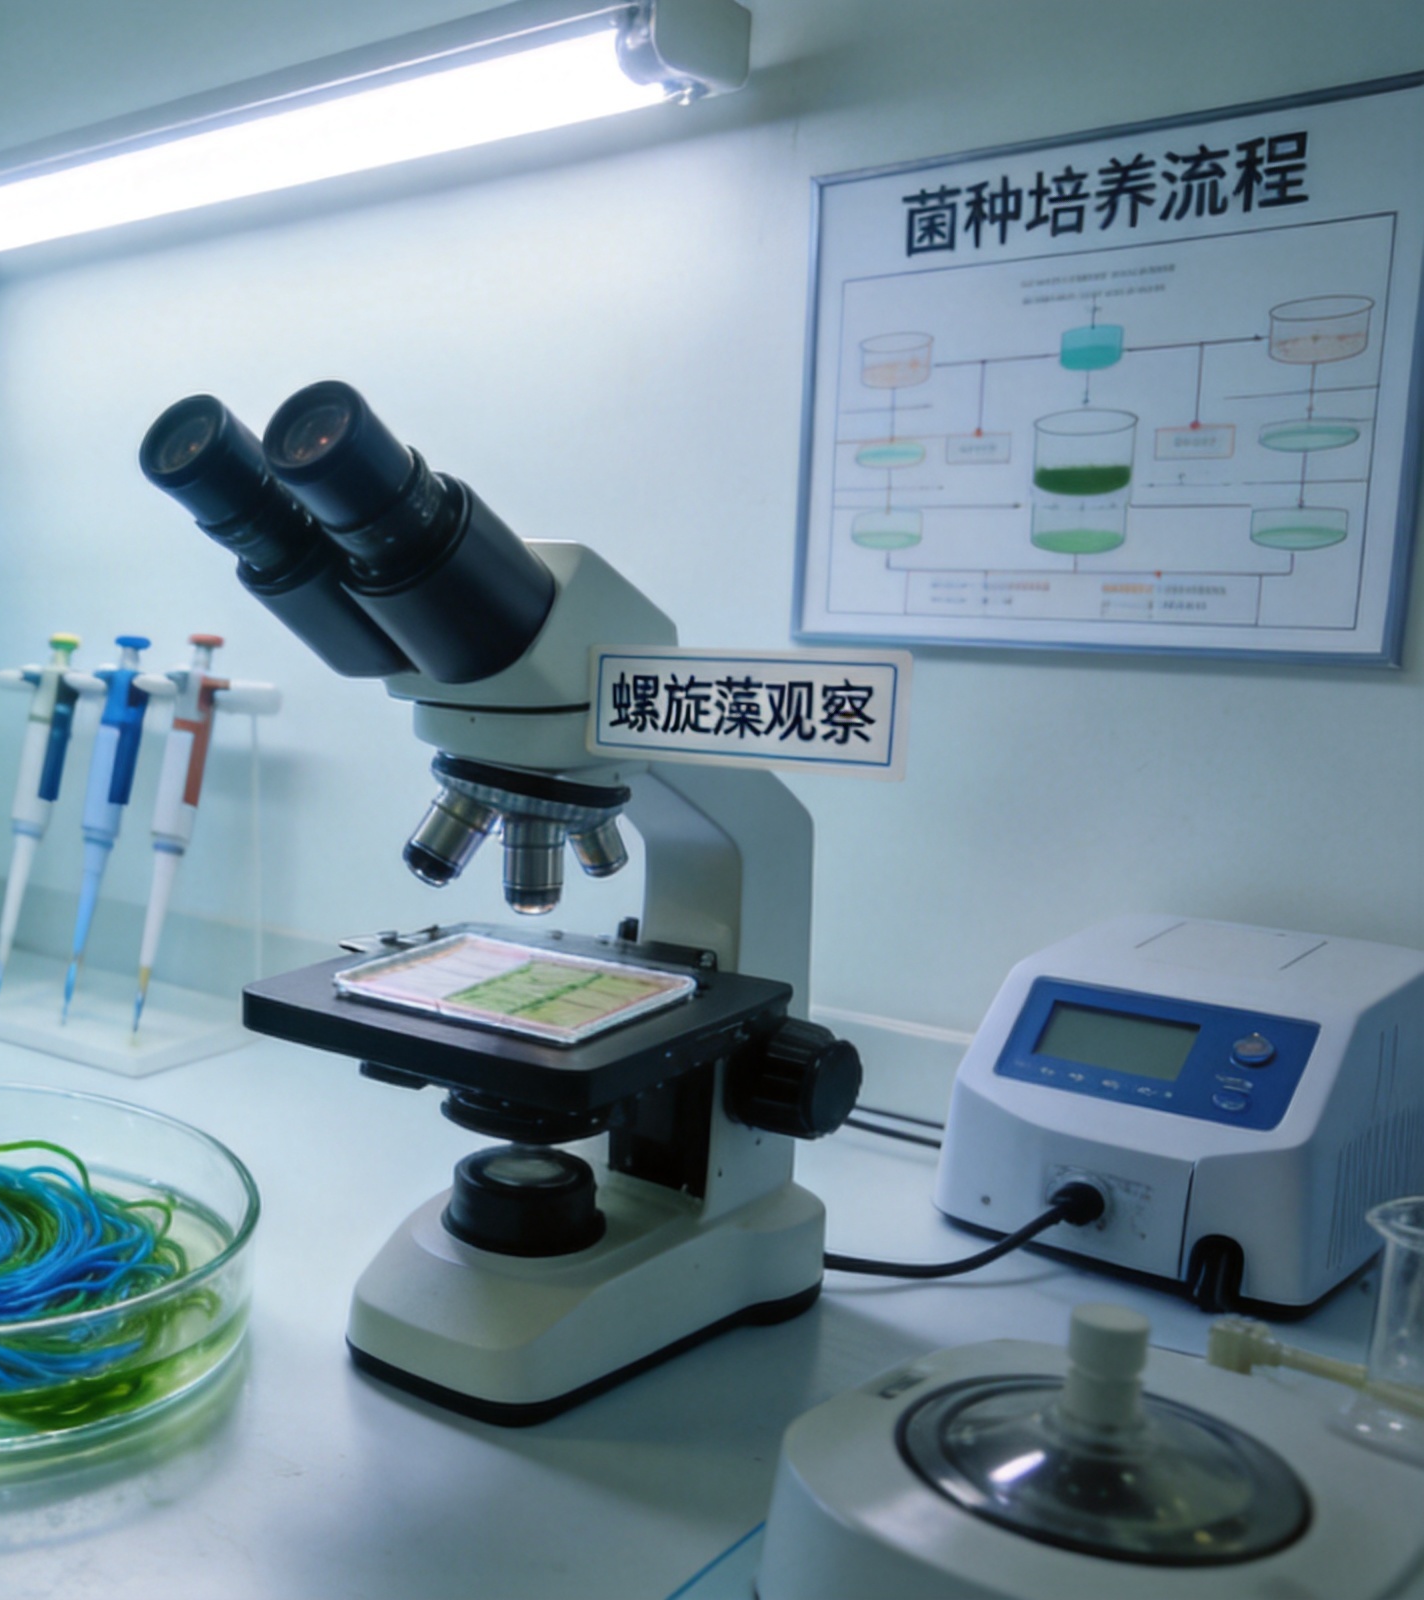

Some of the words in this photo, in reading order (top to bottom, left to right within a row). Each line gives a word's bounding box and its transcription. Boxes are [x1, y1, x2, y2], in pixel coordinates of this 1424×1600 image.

[901, 130, 1310, 258] 菌种培养流程
[608, 671, 877, 745] 螺旋藻观察
